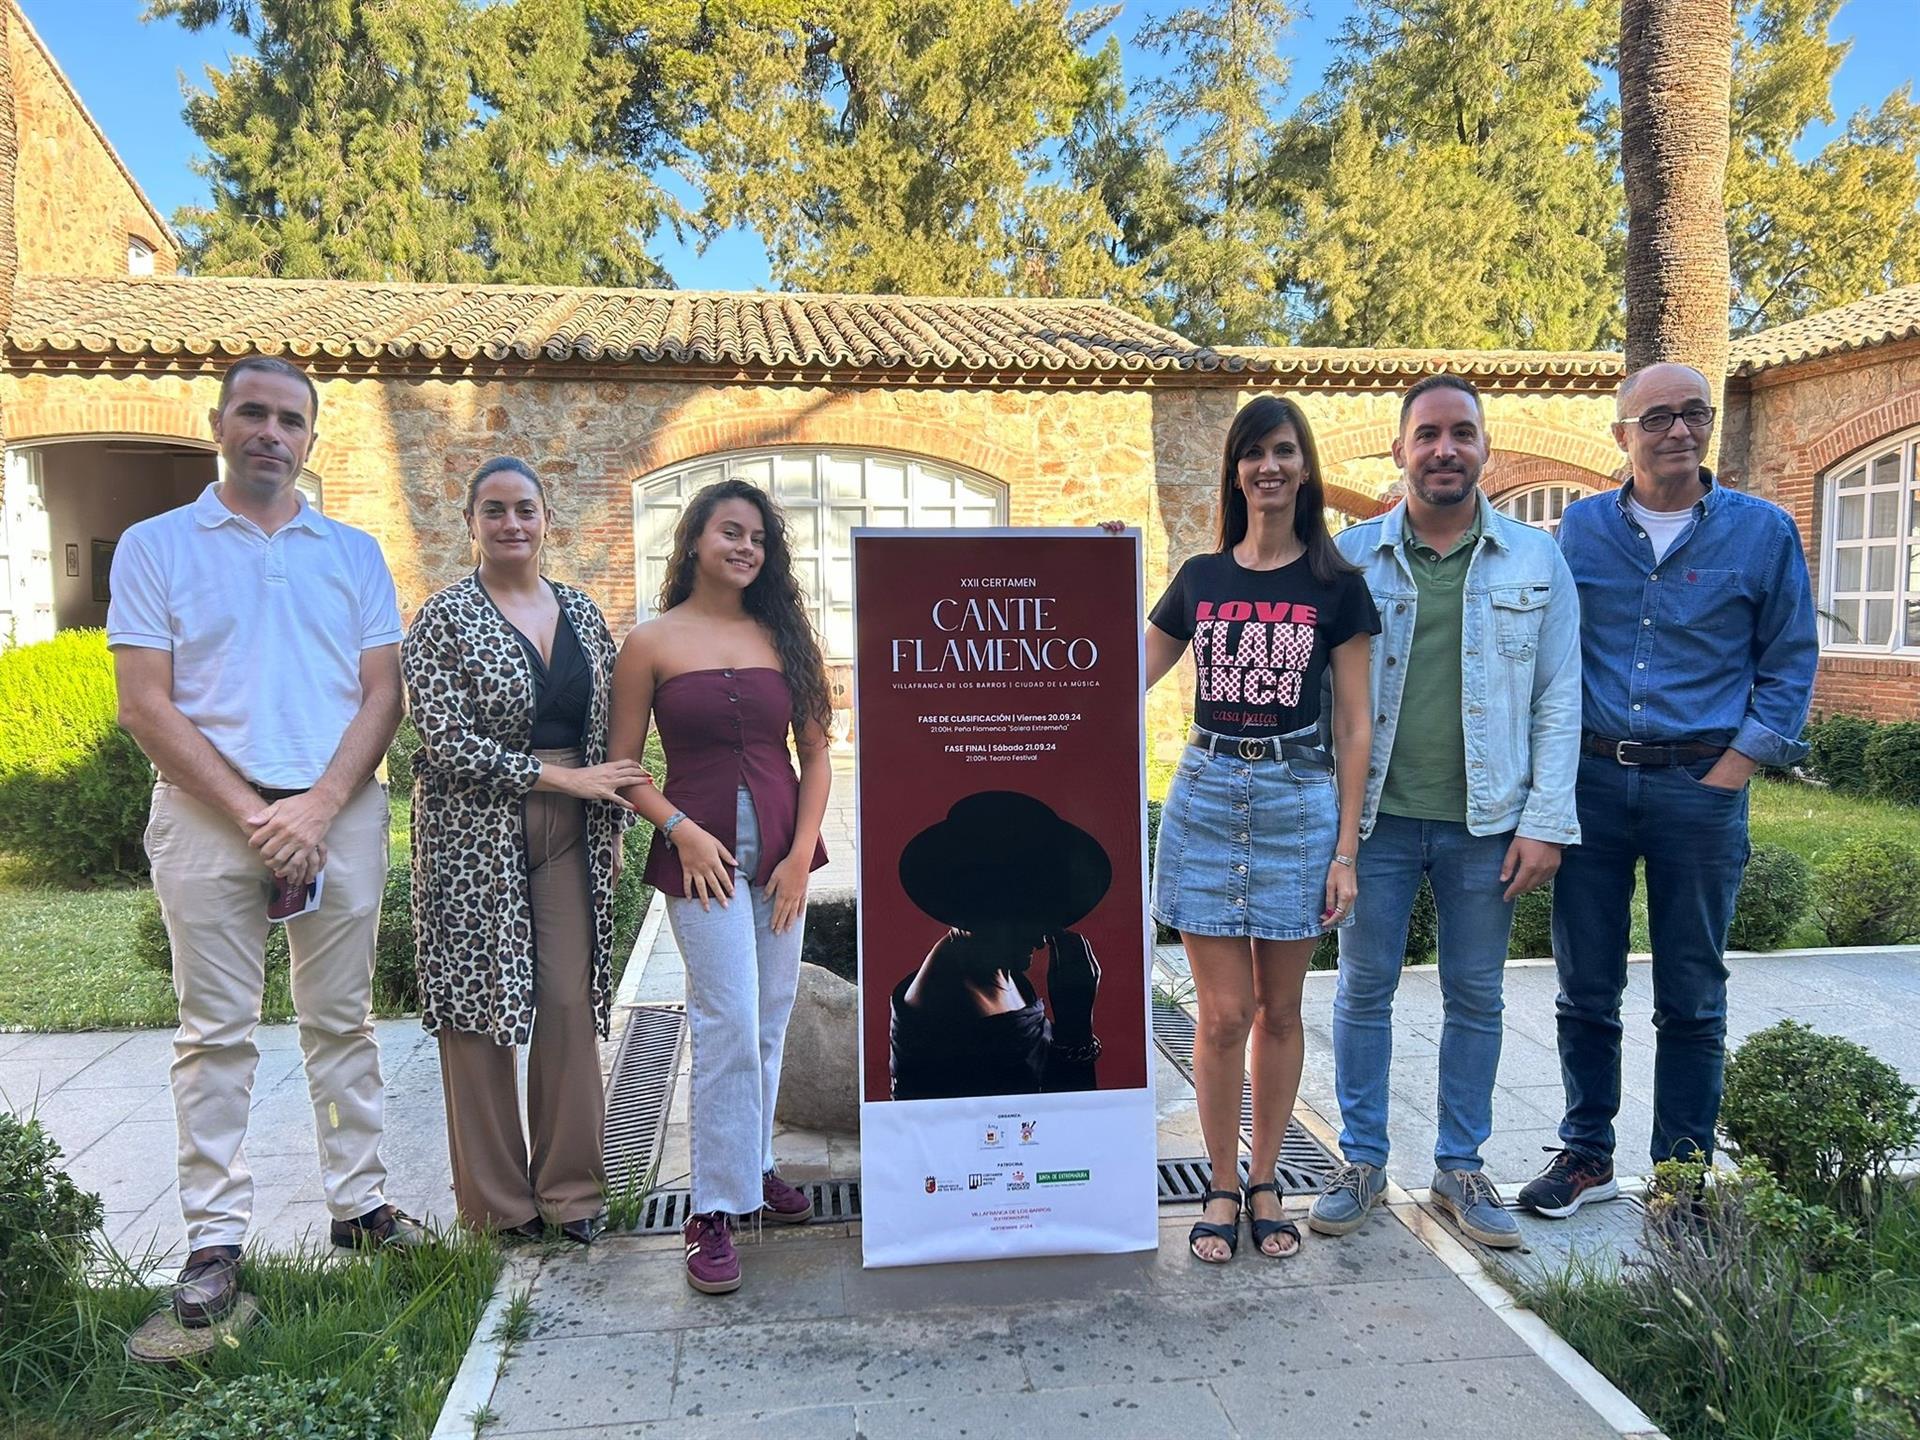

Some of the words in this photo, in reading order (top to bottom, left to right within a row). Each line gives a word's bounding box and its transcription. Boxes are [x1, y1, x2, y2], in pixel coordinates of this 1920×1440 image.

[960, 578, 979, 588] XXII
[981, 577, 1036, 588] CERTAMEN
[932, 598, 1056, 631] CANTE
[1195, 601, 1317, 626] LOVE
[1194, 620, 1314, 671] FLAM
[892, 638, 1098, 672] FLAMENCO
[976, 681, 1006, 689] BARROS
[1071, 679, 1100, 687] MÚSICA
[1199, 667, 1302, 708] ENCO
[918, 715, 938, 723] FASE
[939, 715, 949, 723] DE
[950, 713, 1011, 723] CLASIFICACIÓN
[1017, 713, 1047, 722] Viernes
[1048, 713, 1081, 721] 20.09.24
[1212, 710, 1240, 722] casa
[944, 745, 964, 753] FASE
[965, 745, 987, 753] FINAL
[993, 744, 1024, 752] Sábado
[1025, 743, 1056, 751] 21.09.24
